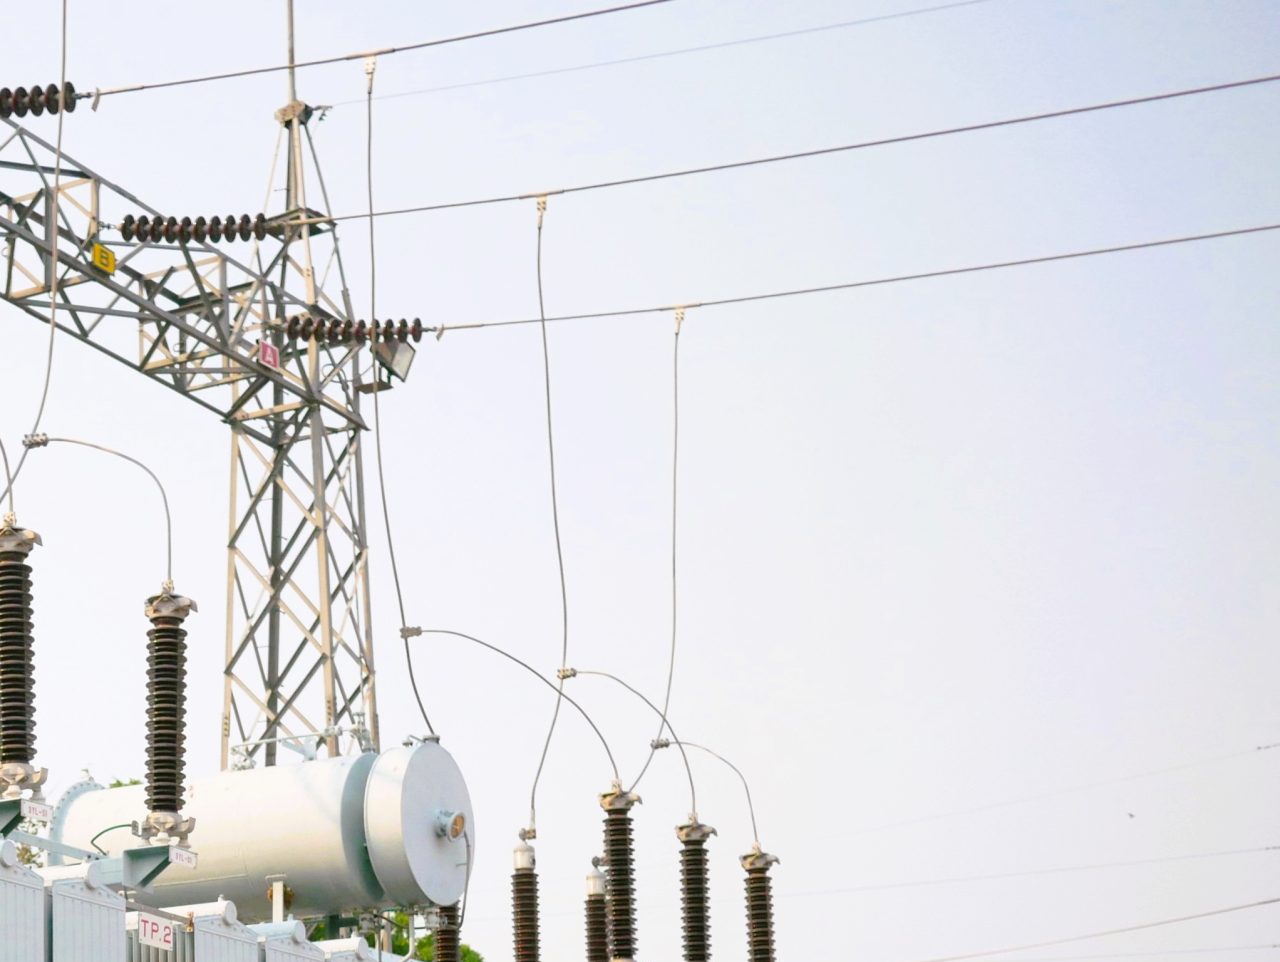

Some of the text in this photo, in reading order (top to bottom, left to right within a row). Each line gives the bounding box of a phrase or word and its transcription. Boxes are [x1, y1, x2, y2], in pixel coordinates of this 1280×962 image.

[100, 249, 110, 267] B
[265, 347, 274, 366] A
[141, 919, 172, 944] TP.2
